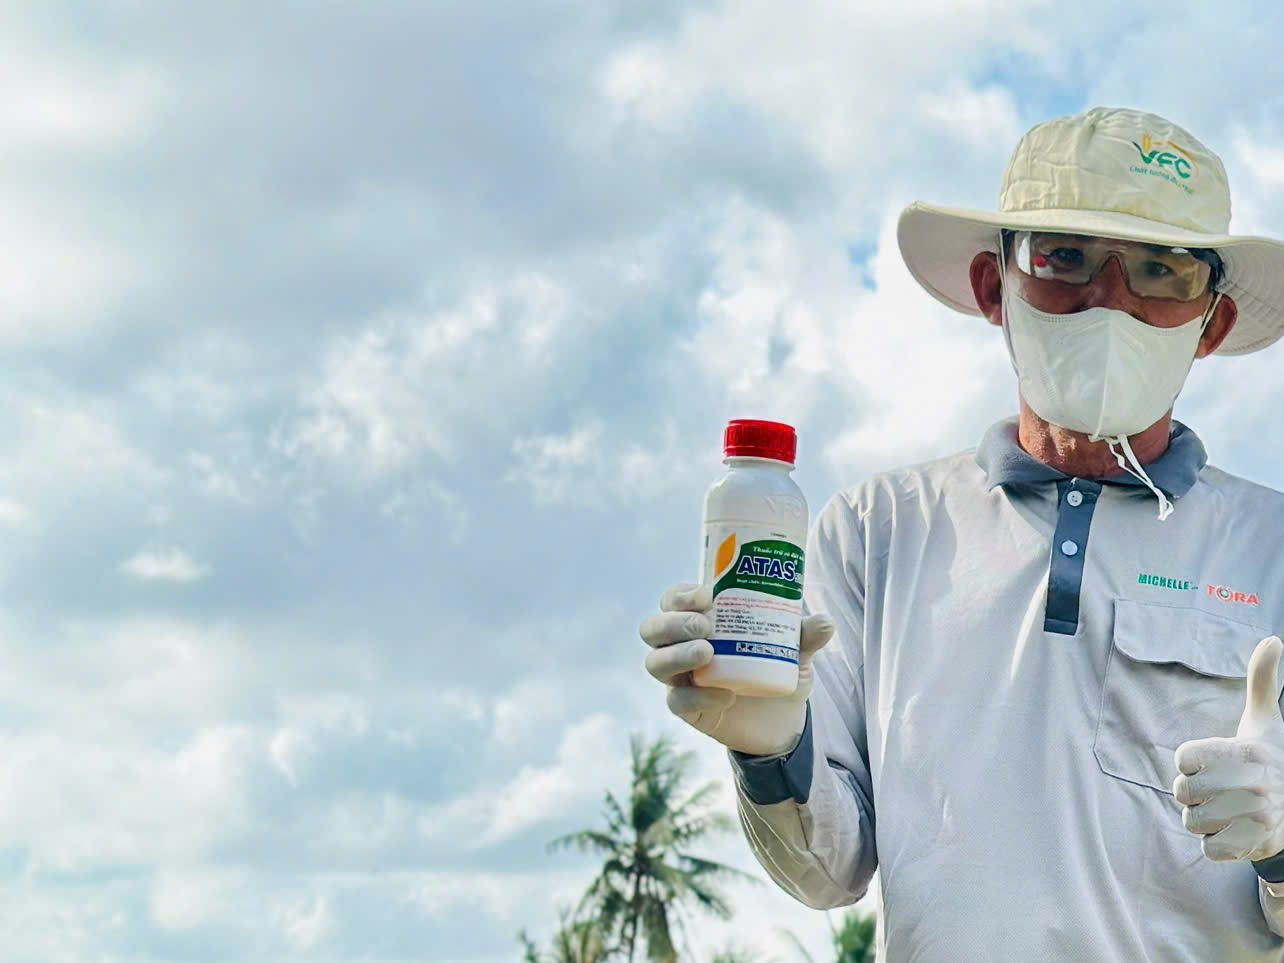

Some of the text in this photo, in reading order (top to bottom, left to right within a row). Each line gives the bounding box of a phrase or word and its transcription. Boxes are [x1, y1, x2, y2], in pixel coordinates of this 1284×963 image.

[1131, 141, 1191, 179] VFC
[736, 555, 796, 582] ATAS
[1138, 573, 1189, 591] MICHELLE
[1207, 583, 1260, 606] TORA
